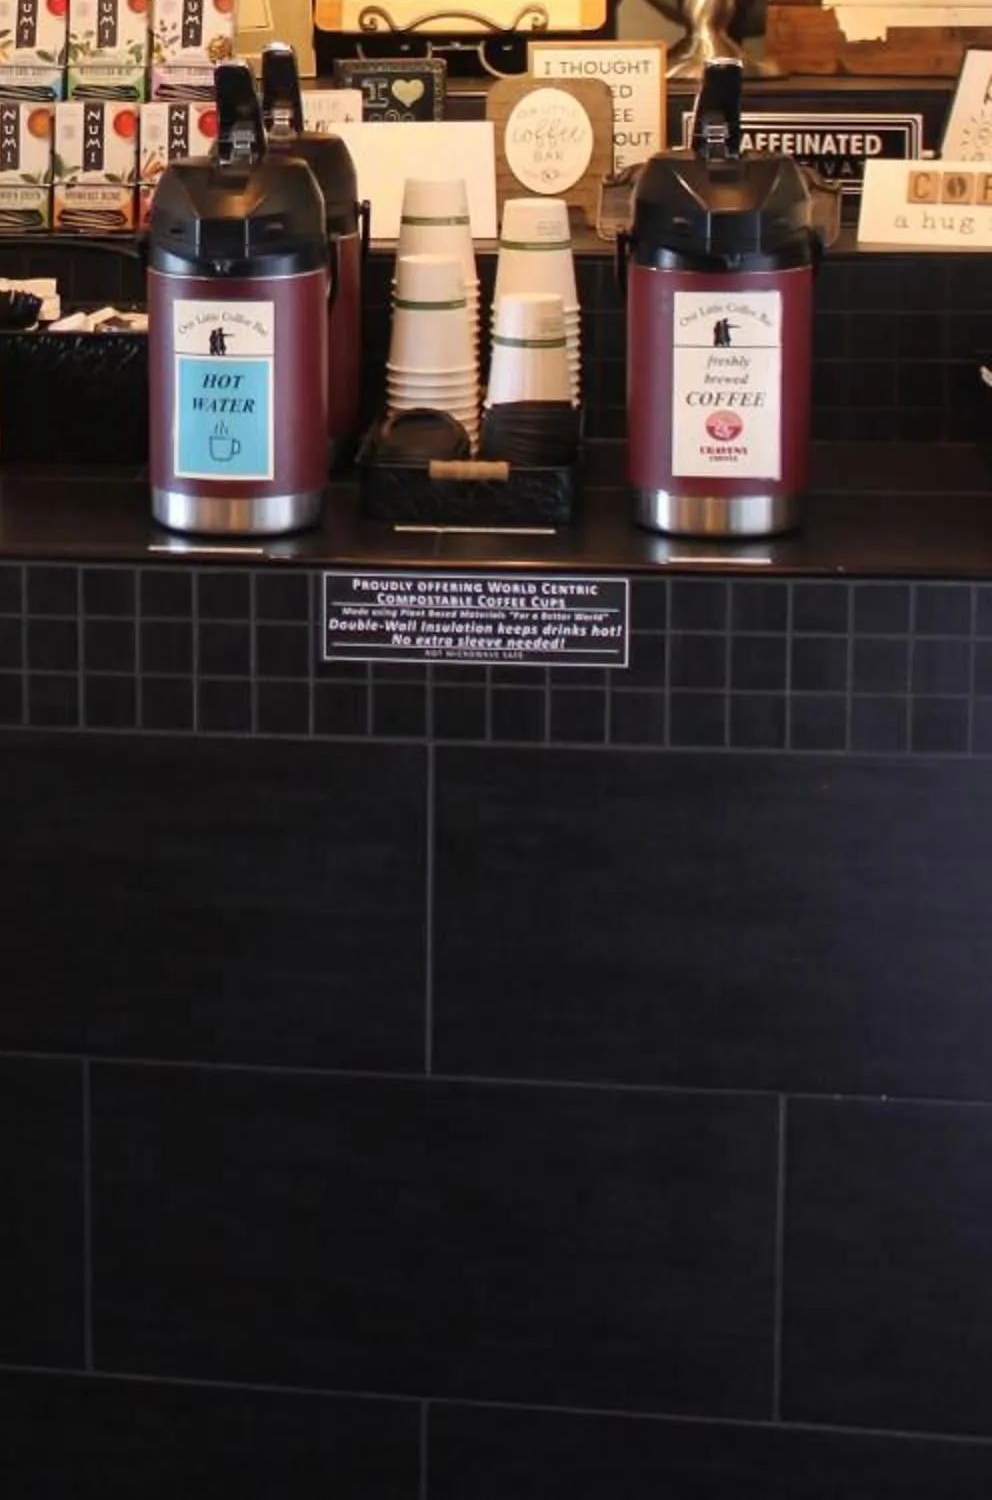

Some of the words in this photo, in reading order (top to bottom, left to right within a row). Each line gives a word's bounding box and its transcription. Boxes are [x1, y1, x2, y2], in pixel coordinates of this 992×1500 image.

[543, 61, 553, 75] I
[559, 59, 651, 75] THOUGHT
[1, 109, 19, 163] NUMI
[85, 110, 103, 163] NUMI
[739, 132, 883, 156] AFFEINATED
[894, 215, 910, 229] a
[922, 210, 976, 235] hug
[202, 373, 246, 389] HOT
[191, 397, 257, 414] WATER
[685, 390, 768, 408] COFFEE
[352, 578, 414, 592] PROUDLY
[417, 580, 484, 594] OFFERING
[487, 581, 537, 595] WORLD
[541, 582, 599, 596] CENTRIC
[376, 592, 473, 607] COMPOSTABLE
[477, 595, 526, 608] COFFEE
[531, 596, 567, 609] CUPS
[328, 617, 418, 633] Double-Wall
[421, 620, 494, 634] Insulation
[497, 621, 539, 637] keeps
[542, 623, 588, 638] drinks
[591, 624, 623, 638] hot!
[391, 633, 412, 646] No
[415, 634, 454, 647] extra
[458, 635, 504, 649] sleeve
[507, 637, 567, 650] needed!
